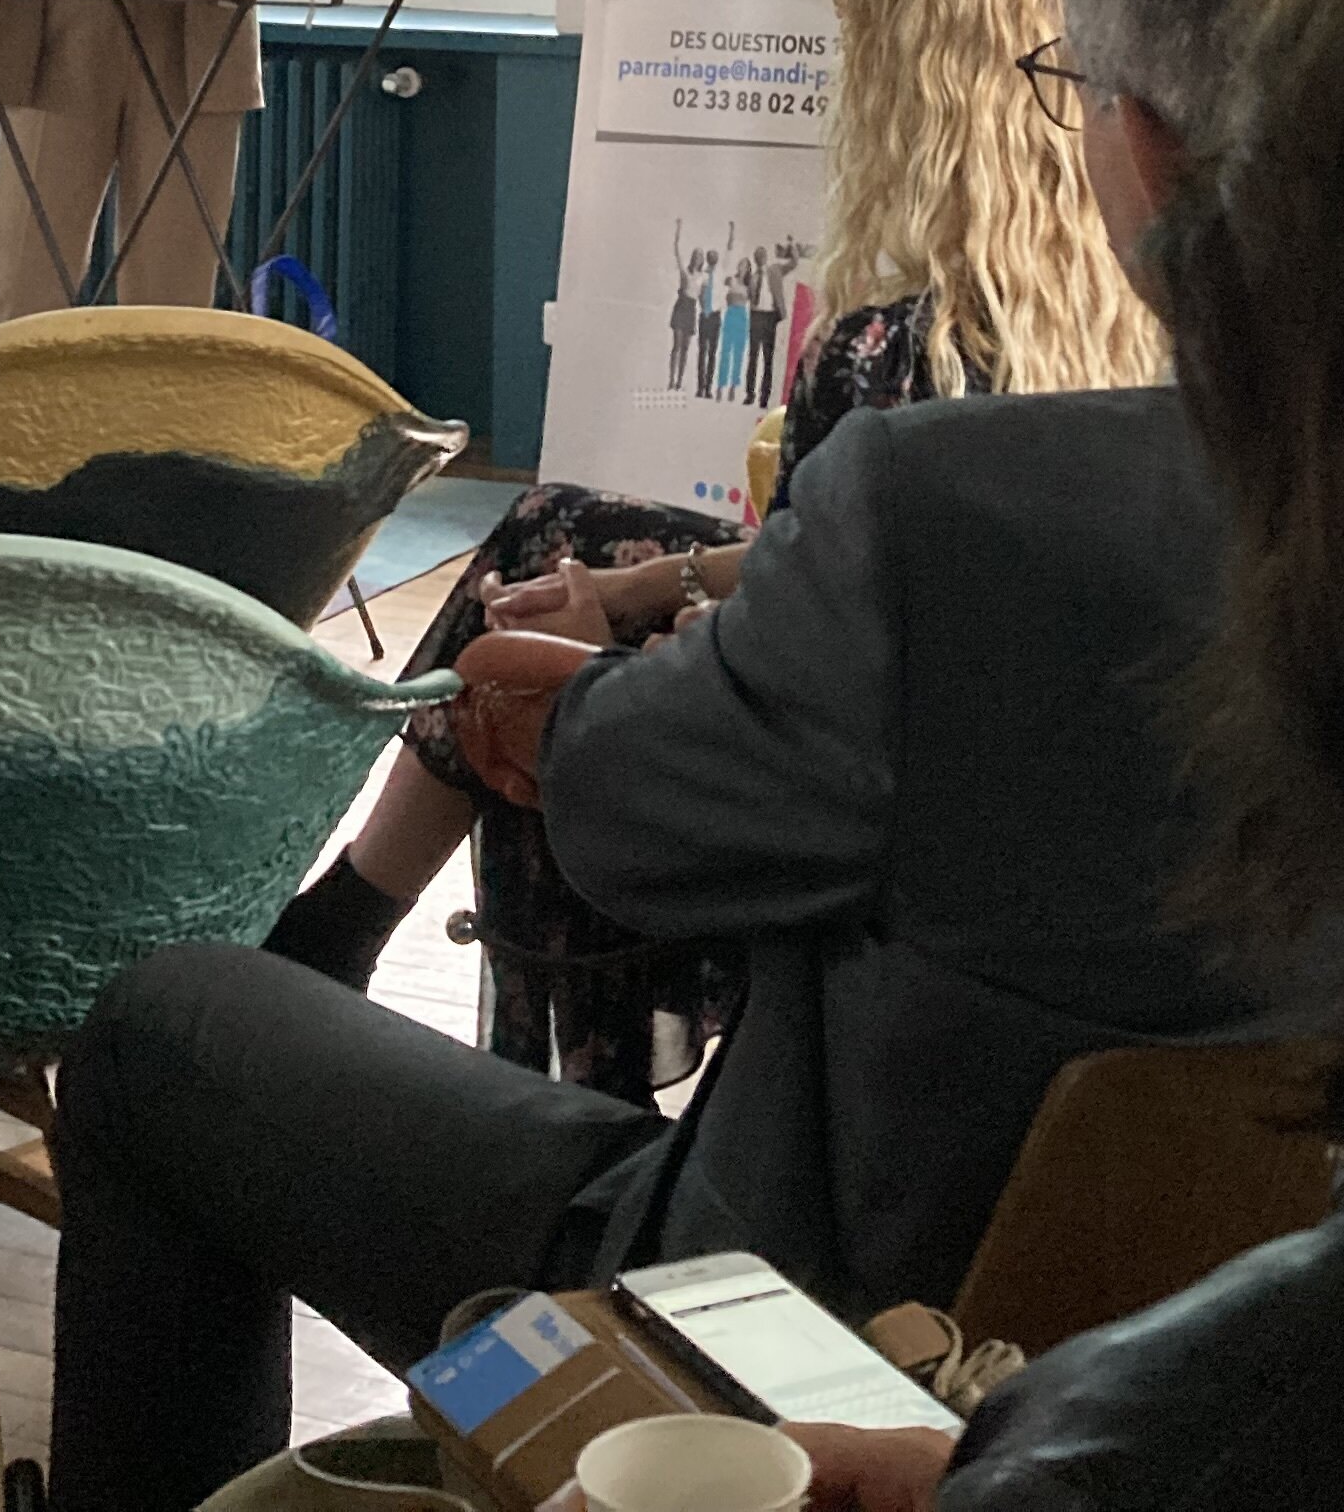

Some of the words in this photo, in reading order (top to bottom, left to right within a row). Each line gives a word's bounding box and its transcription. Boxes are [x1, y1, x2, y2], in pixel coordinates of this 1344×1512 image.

[670, 30, 706, 50] DES
[712, 32, 826, 56] QUESTIONS
[618, 57, 836, 91] parrainage@handi-p
[673, 88, 699, 108] 02
[704, 90, 730, 110] 33
[736, 91, 762, 112] 88
[768, 93, 795, 115] 02
